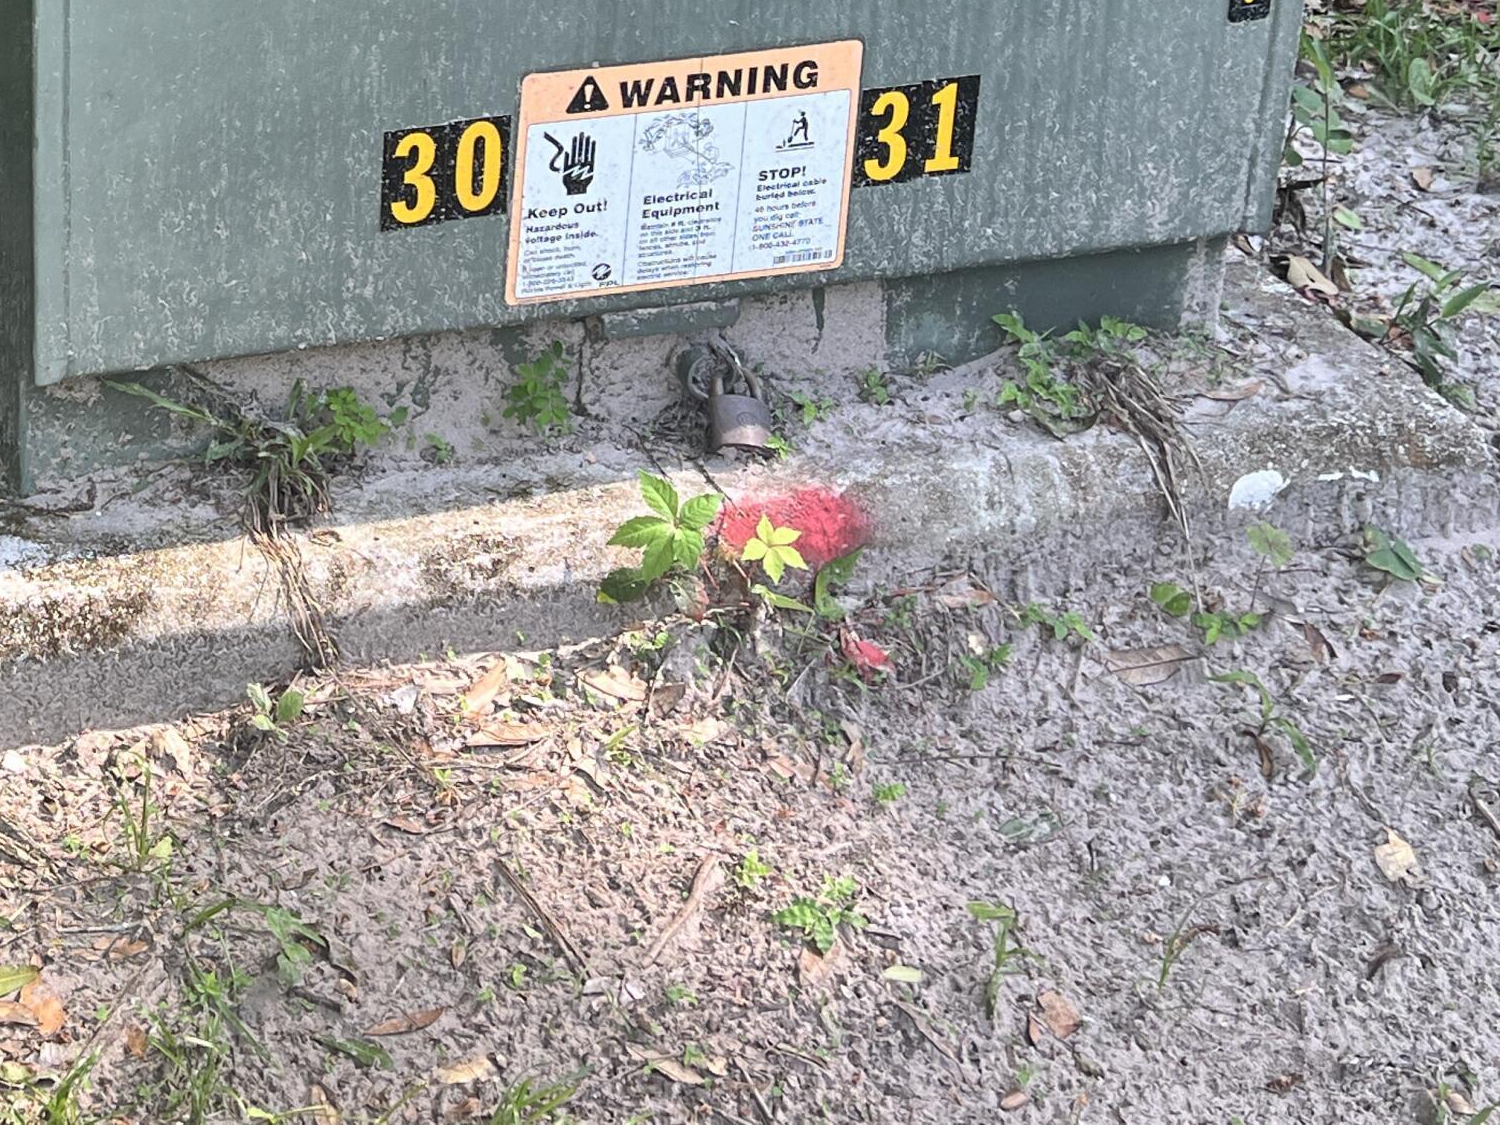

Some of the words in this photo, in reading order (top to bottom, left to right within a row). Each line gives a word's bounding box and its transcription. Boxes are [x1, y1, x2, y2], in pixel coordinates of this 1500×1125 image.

[619, 59, 819, 109] WARNING
[863, 82, 960, 181] 31
[390, 120, 502, 224] 30
[758, 165, 807, 182] STOP!
[756, 181, 800, 192] Electrical
[802, 178, 827, 187] cable
[643, 188, 713, 205] Electrical
[527, 206, 569, 220] Keep
[573, 198, 608, 214] Out!
[642, 201, 720, 220] Equipment
[525, 221, 579, 234] Hazardous
[772, 230, 794, 240] CALL
[598, 280, 620, 288] FPL
